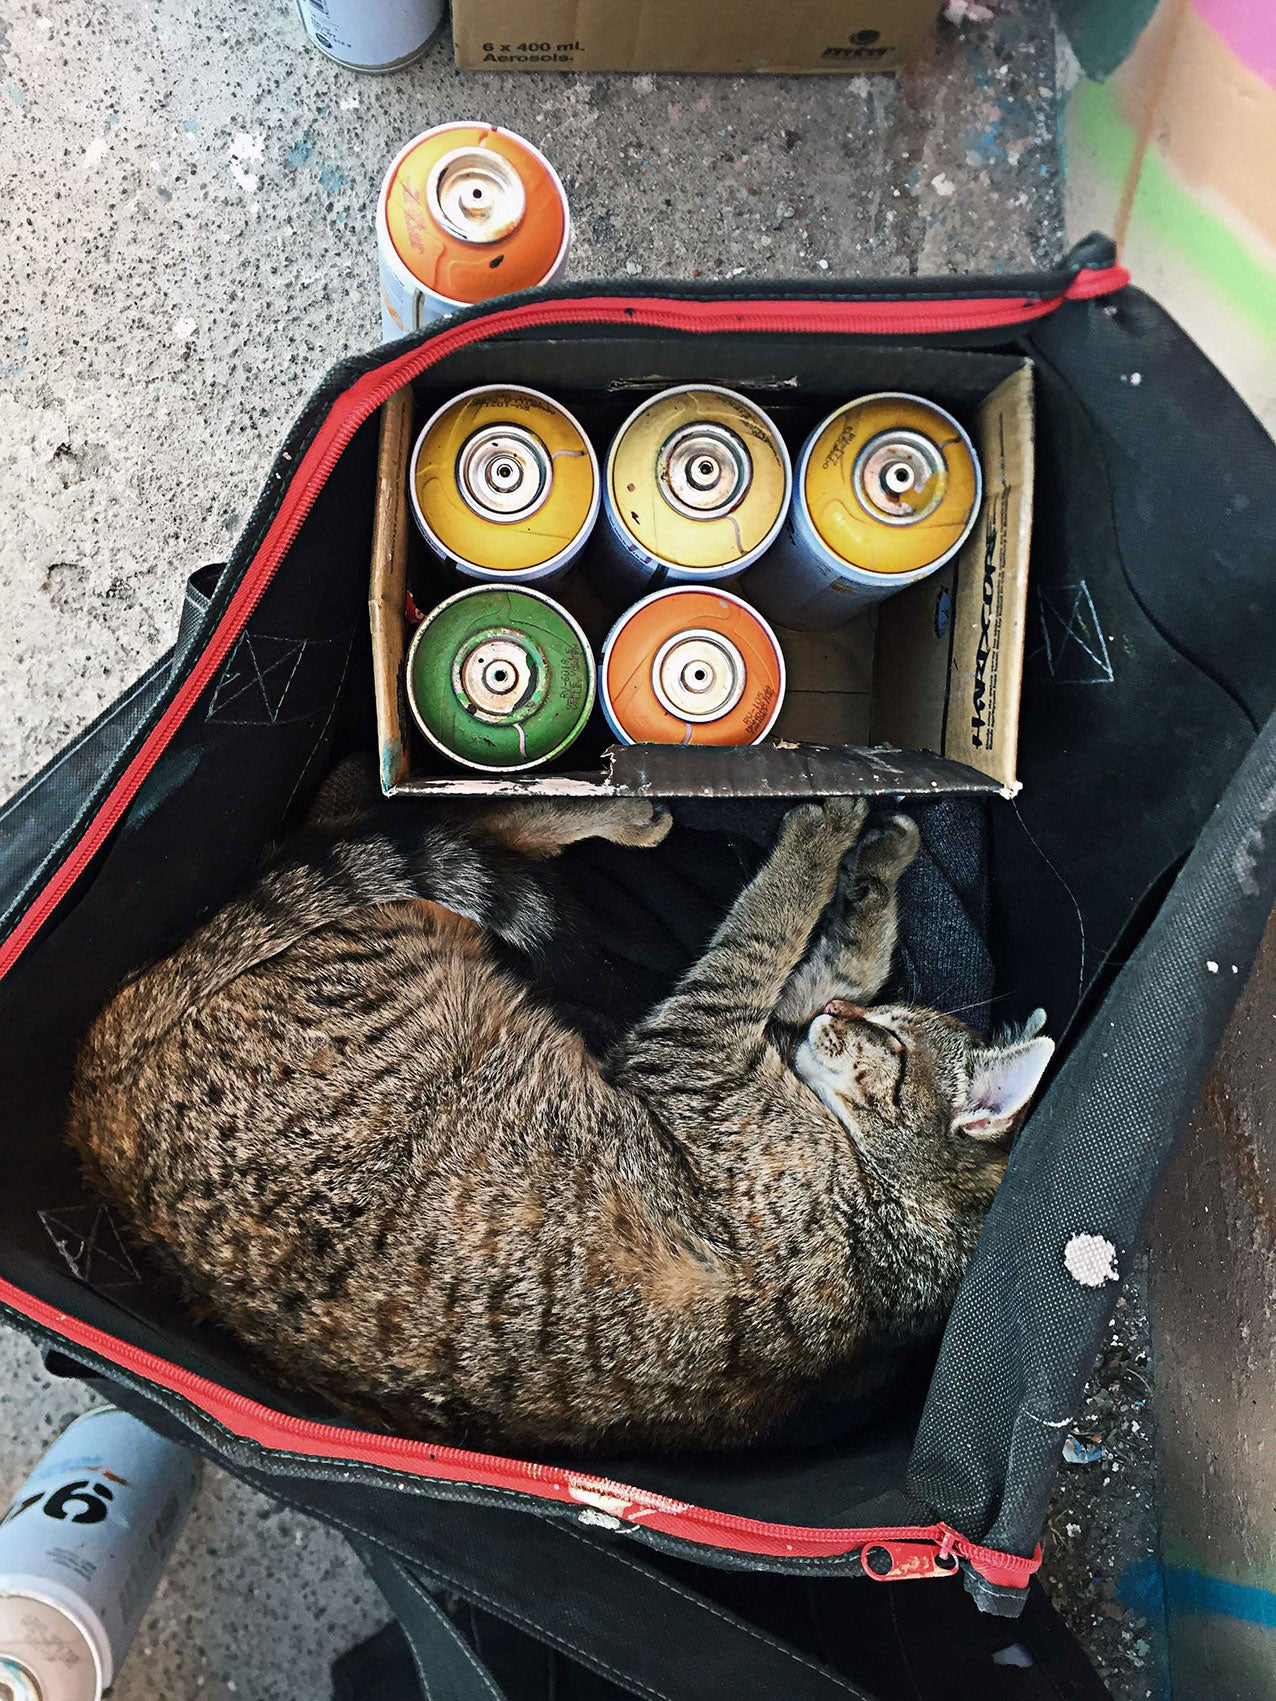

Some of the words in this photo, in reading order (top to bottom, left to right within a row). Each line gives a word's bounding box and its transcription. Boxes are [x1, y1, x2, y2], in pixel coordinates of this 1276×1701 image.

[482, 42, 495, 52] 6
[500, 44, 511, 52] x
[517, 41, 551, 52] 400
